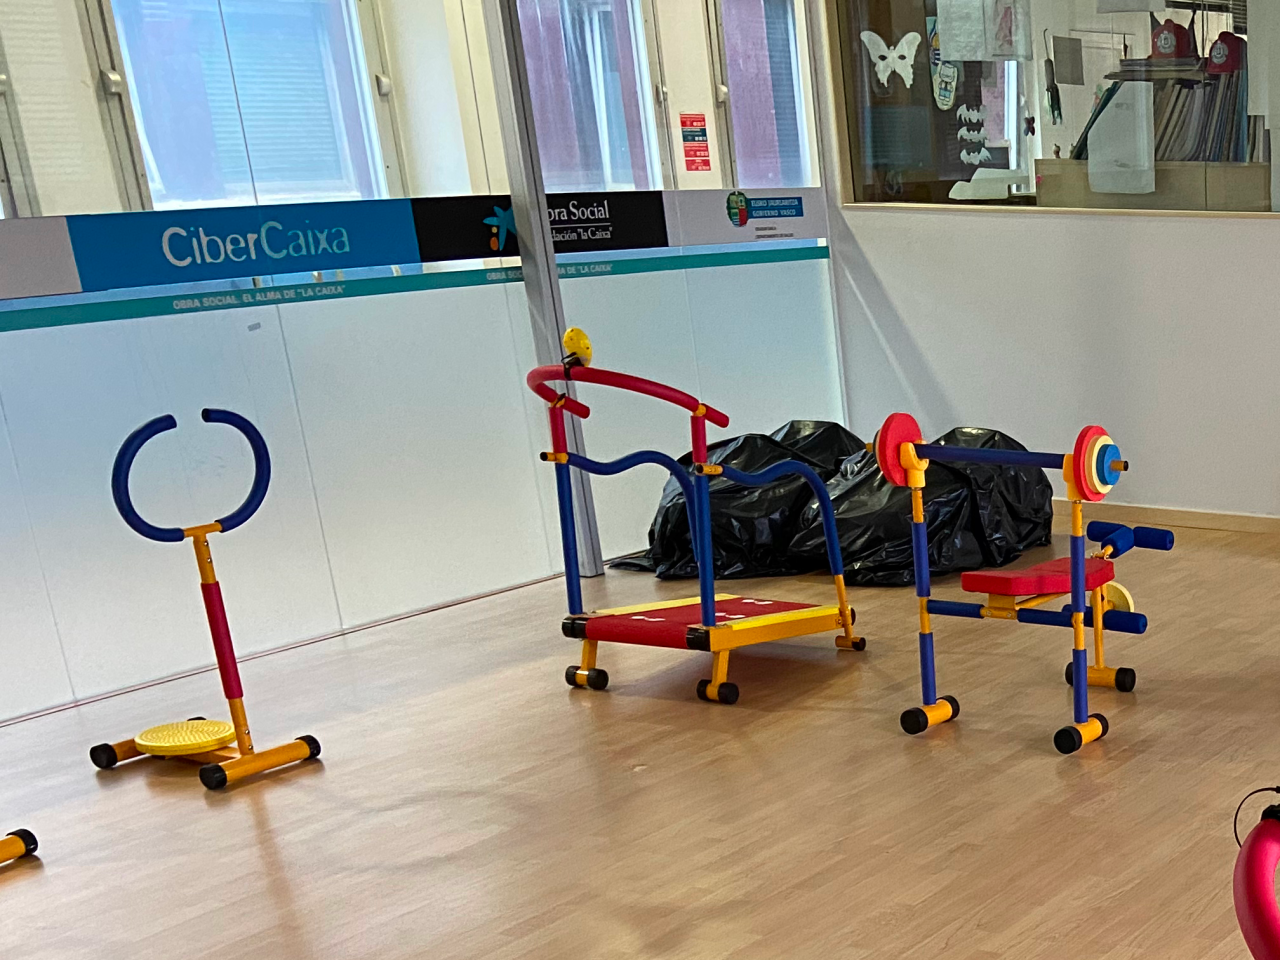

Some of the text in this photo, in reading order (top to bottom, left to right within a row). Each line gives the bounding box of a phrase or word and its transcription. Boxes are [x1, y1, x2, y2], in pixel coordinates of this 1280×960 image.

[547, 199, 610, 221] bra Social
[161, 220, 351, 268] CiberCaixa
[551, 229, 578, 241] dación
[566, 265, 577, 275] DE
[172, 299, 201, 310] OBRA
[242, 293, 254, 303] EL
[255, 290, 282, 301] ALMA
[282, 289, 297, 299] DE
